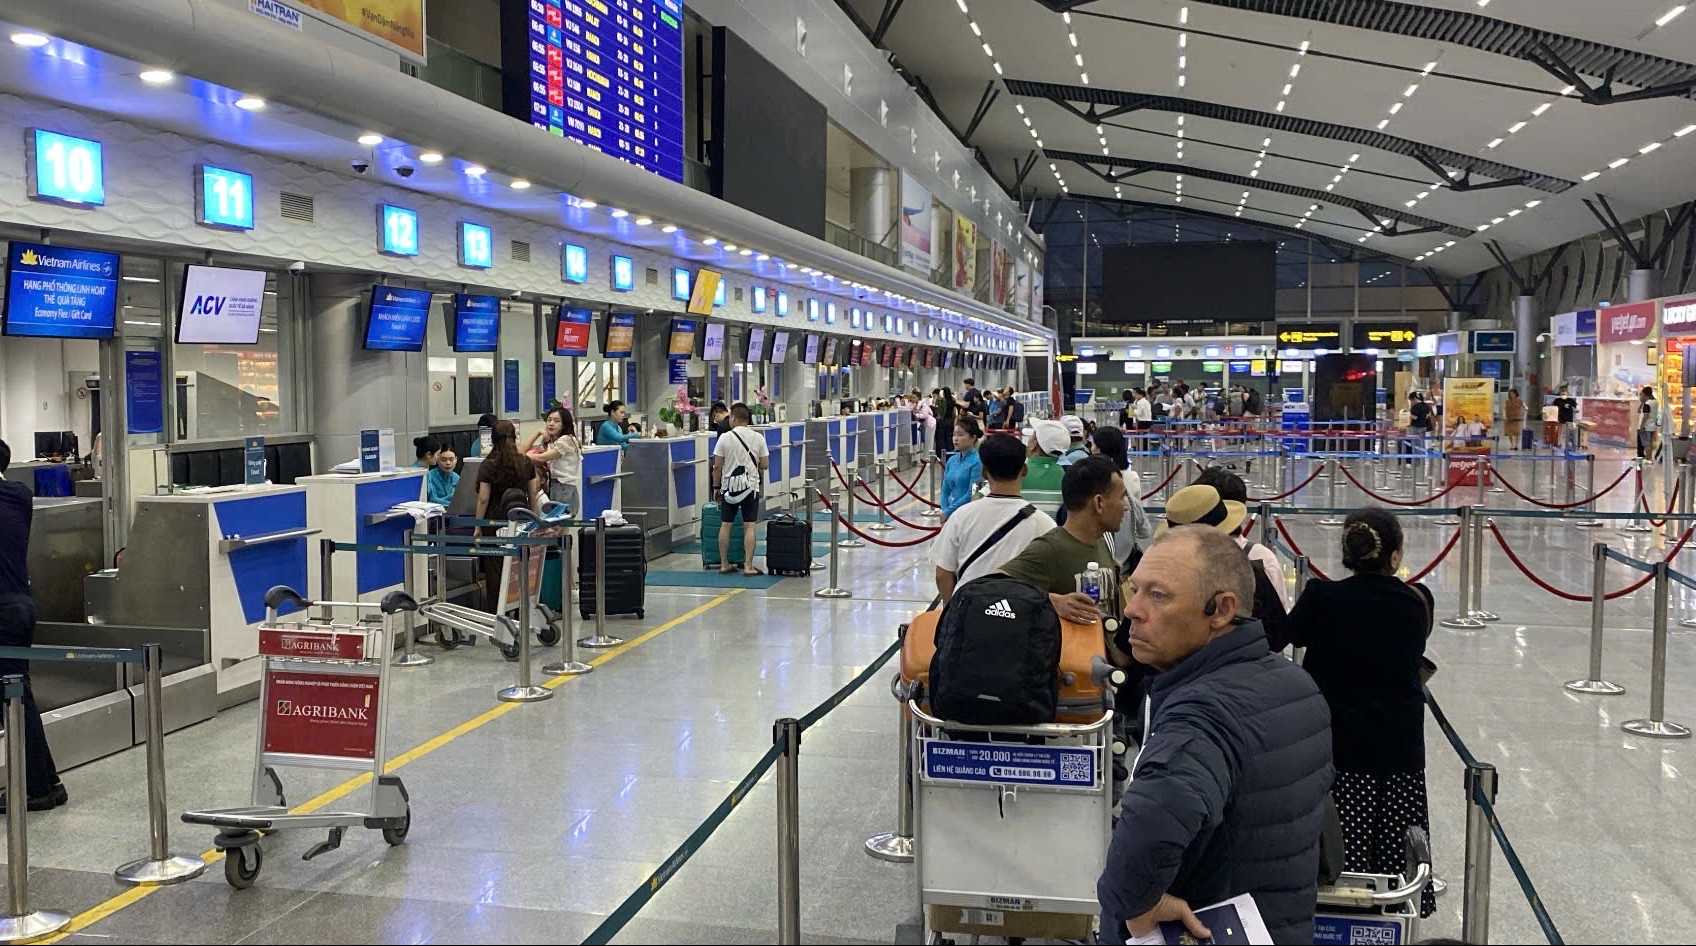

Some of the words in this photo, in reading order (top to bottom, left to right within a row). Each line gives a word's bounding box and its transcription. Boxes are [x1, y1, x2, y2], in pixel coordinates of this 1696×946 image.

[45, 141, 93, 194] 10
[212, 174, 244, 220] 11
[387, 212, 413, 248] 12
[466, 229, 488, 261] 13
[39, 255, 72, 268] Vietnam
[72, 259, 100, 272] Airlines
[190, 295, 227, 315] ACV
[35, 307, 57, 320] Economy
[72, 309, 80, 319] Gift
[81, 310, 92, 320] Card
[1663, 306, 1686, 324] LUCKY
[985, 608, 1015, 619] adidas
[292, 642, 339, 652] AGRIBANK
[292, 705, 368, 720] AGRIBANK
[933, 748, 965, 756] BIZMAN
[979, 751, 1010, 761] 20.000
[933, 765, 946, 773] LIÊN
[975, 766, 986, 776] CÁO
